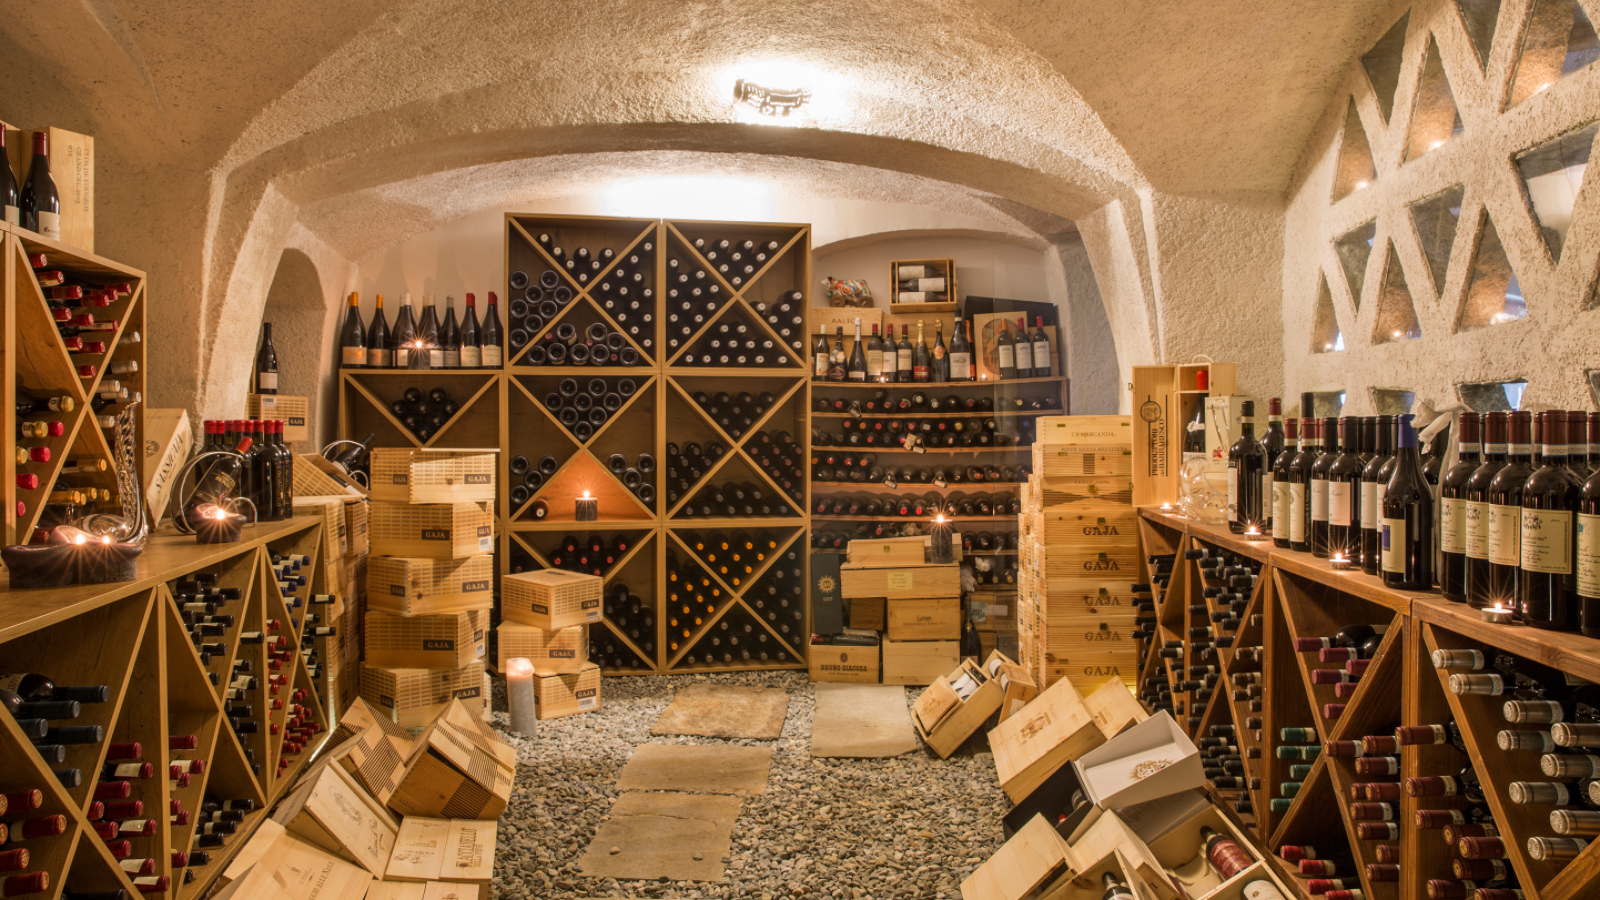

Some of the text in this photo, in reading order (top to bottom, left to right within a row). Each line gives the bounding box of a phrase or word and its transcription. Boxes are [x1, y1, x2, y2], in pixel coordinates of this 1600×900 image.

[425, 531, 446, 539] GAJA
[1082, 525, 1120, 536] GAJA
[1083, 561, 1120, 571] GAJA
[465, 582, 485, 590] GAJA
[582, 600, 598, 608] GAJA
[1084, 596, 1121, 606] GAJA
[533, 605, 547, 614] GAJA
[1084, 631, 1122, 642] GAJA
[427, 641, 449, 649] GAJA
[1083, 666, 1121, 676] GAJA
[456, 689, 477, 698] GAJA
[577, 690, 594, 698] GAJA
